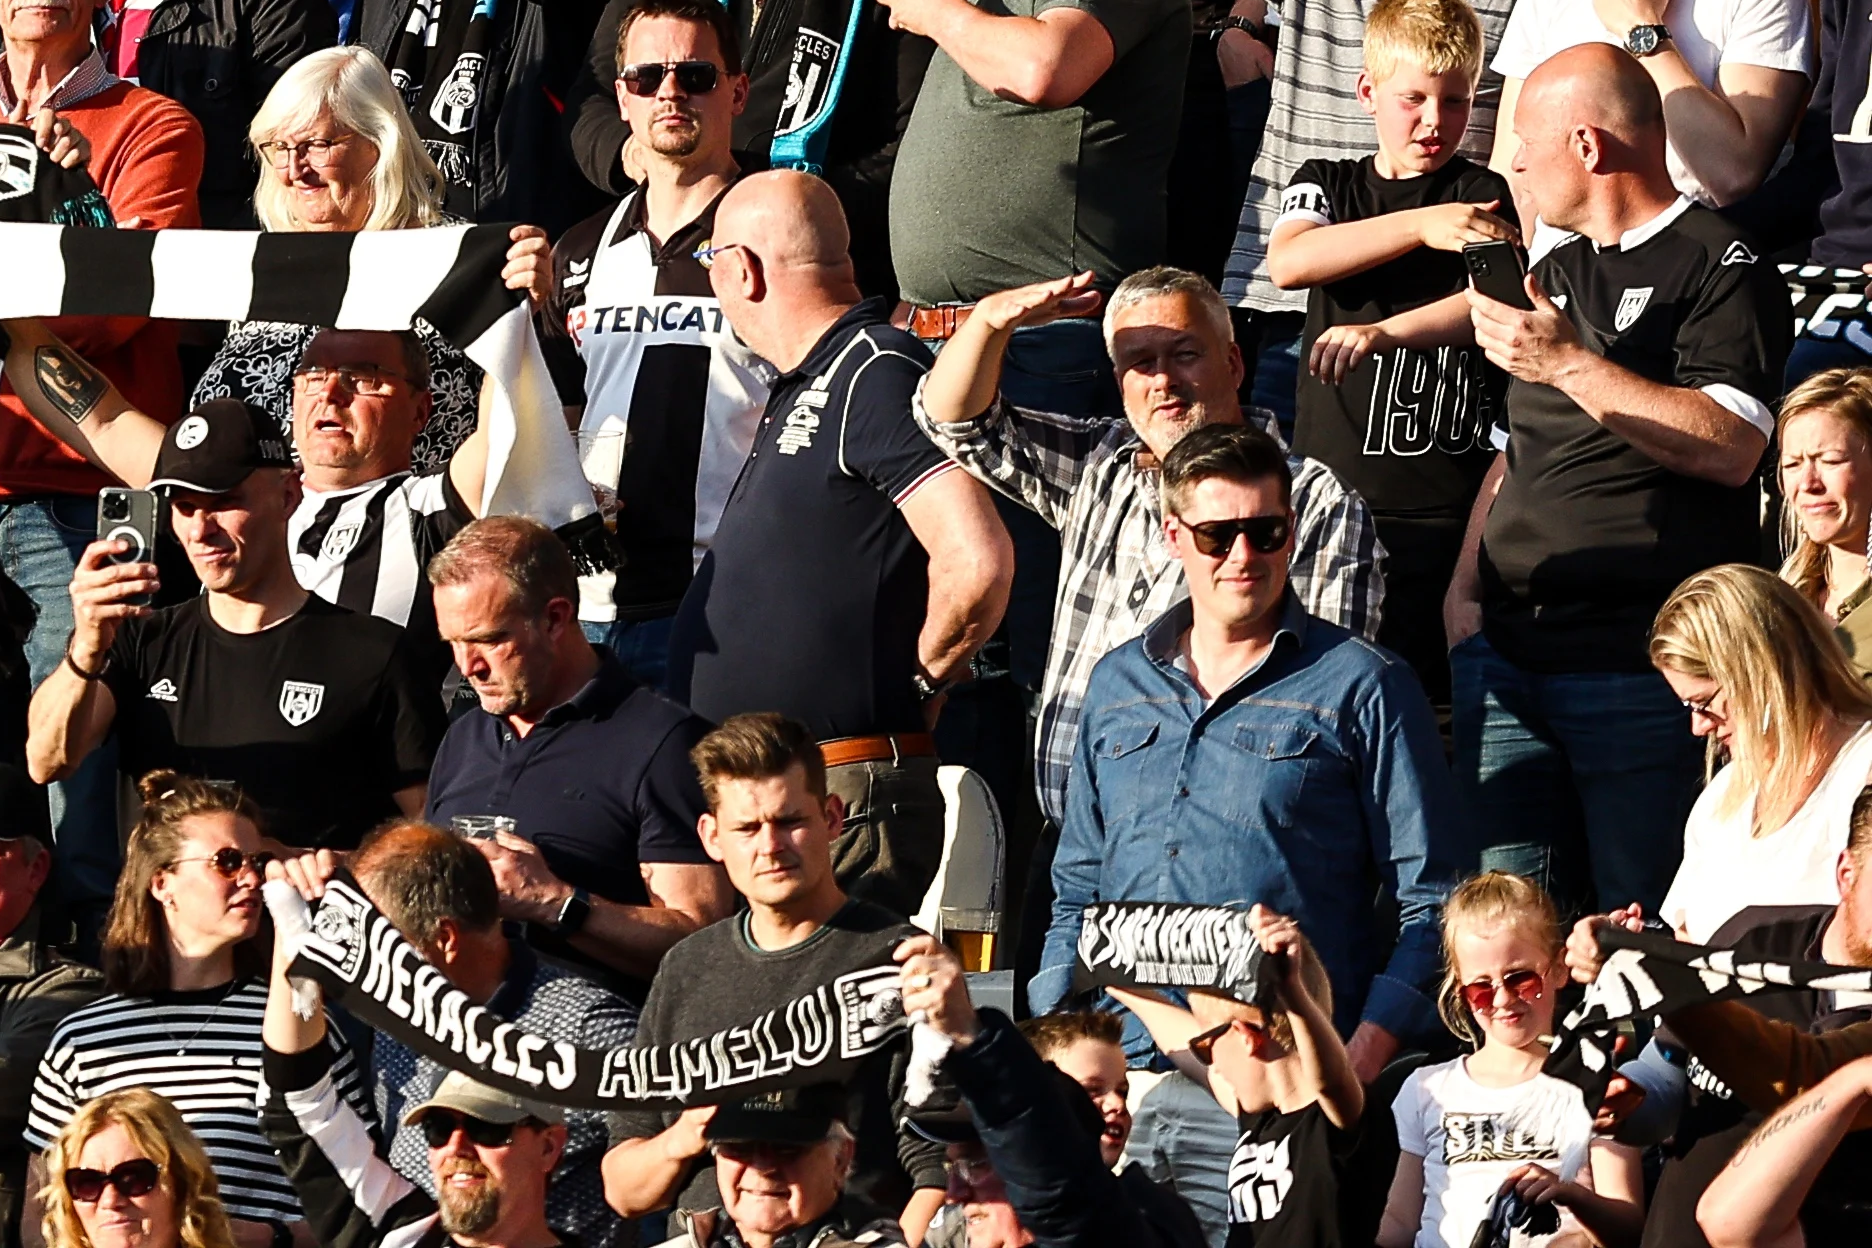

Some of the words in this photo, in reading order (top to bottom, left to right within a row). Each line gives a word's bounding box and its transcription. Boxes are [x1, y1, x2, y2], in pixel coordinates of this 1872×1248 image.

[364, 917, 576, 1090] HERACLES
[597, 987, 836, 1102] ALMELO
[1444, 1114, 1558, 1155] STYL
